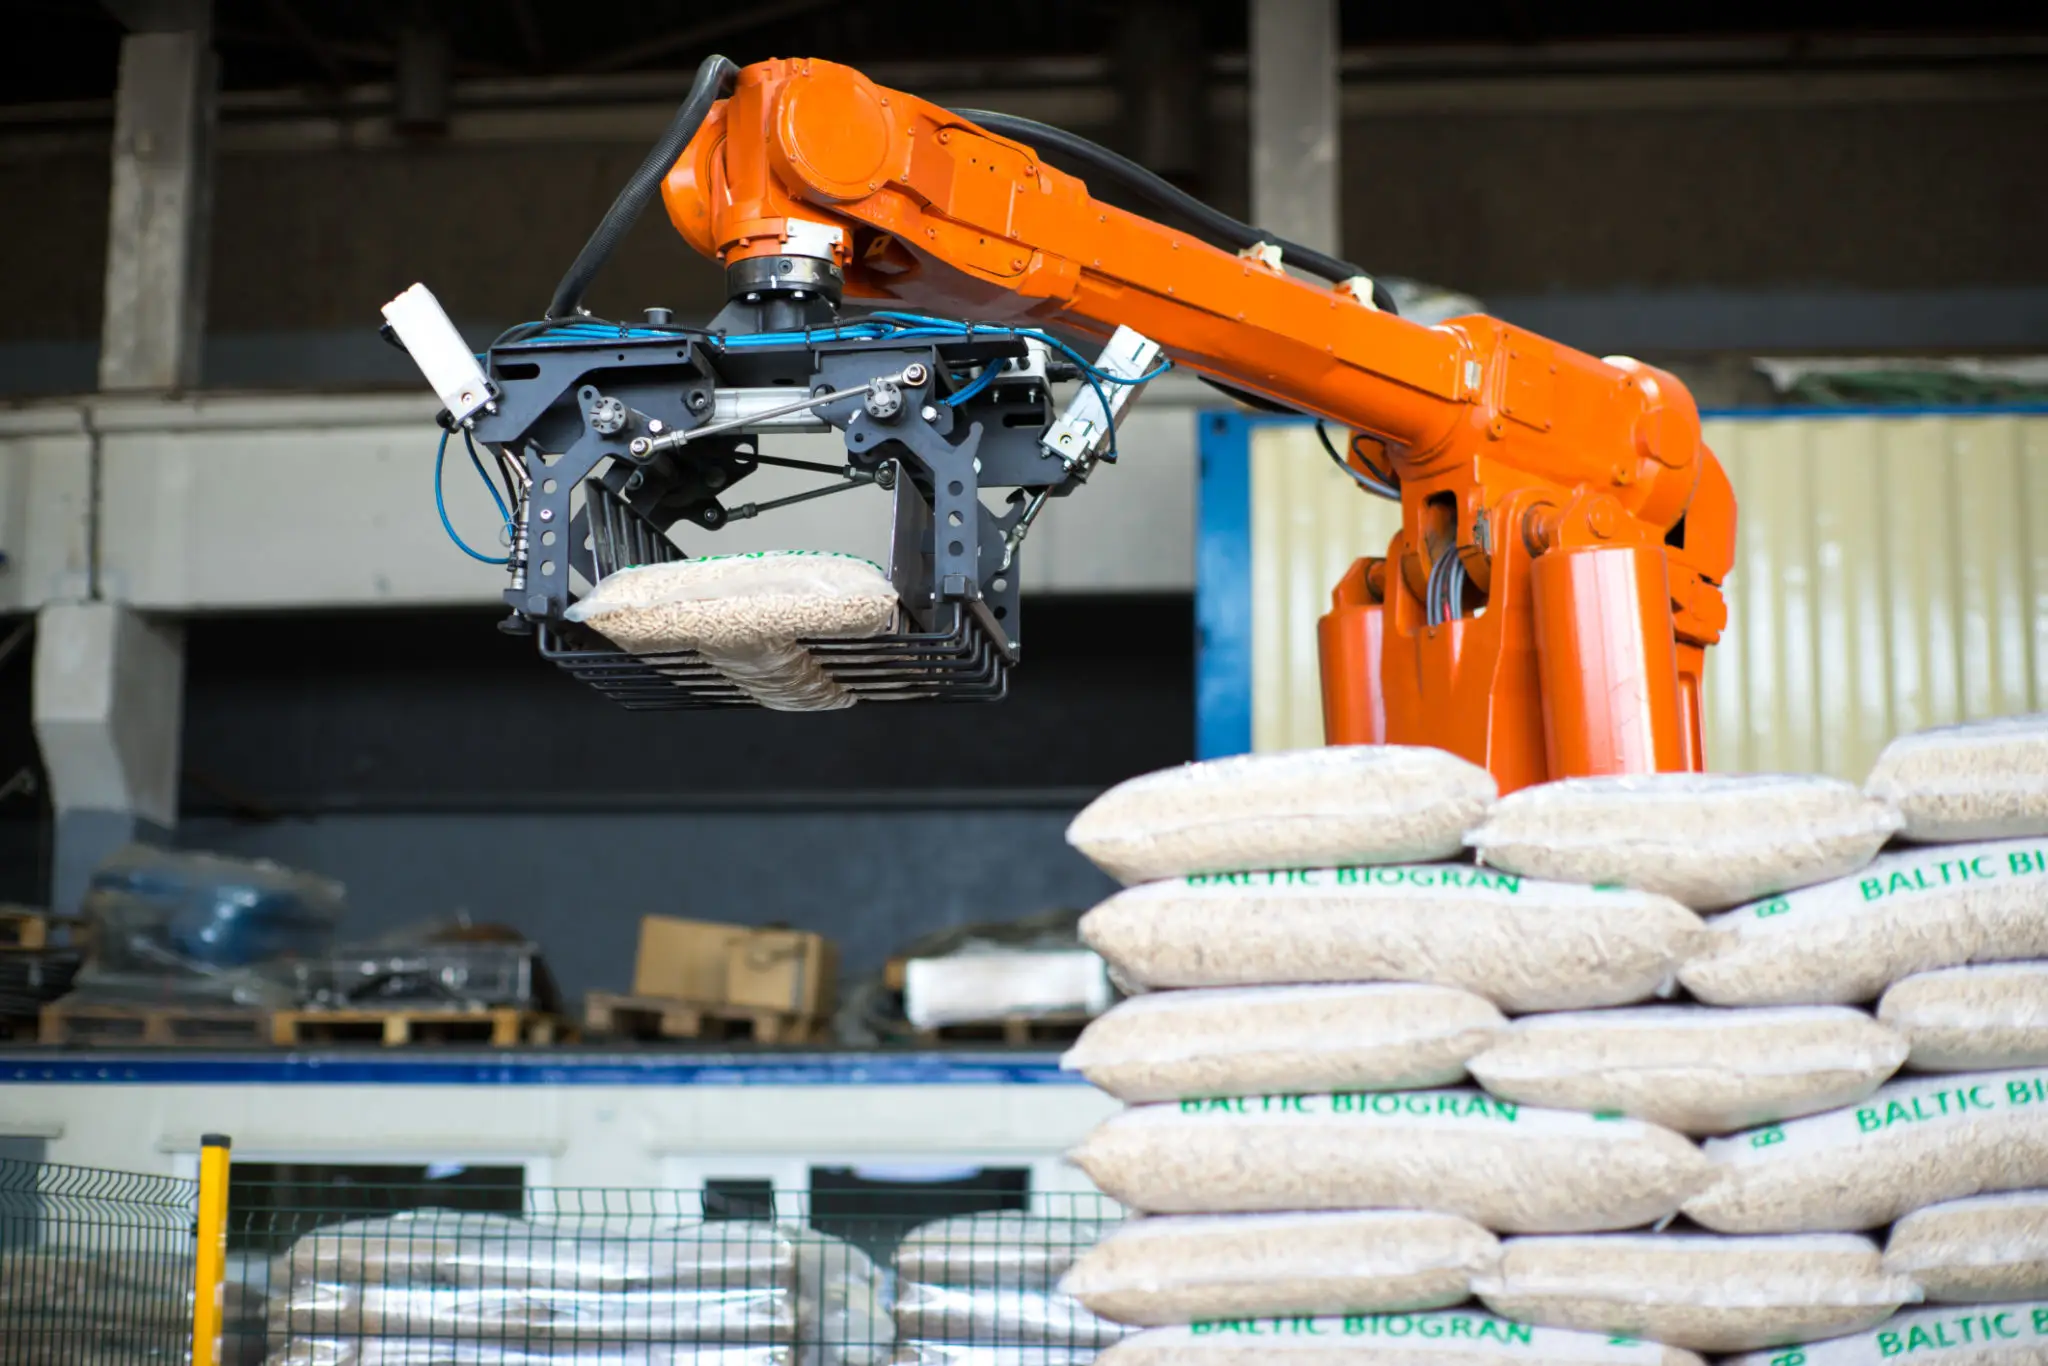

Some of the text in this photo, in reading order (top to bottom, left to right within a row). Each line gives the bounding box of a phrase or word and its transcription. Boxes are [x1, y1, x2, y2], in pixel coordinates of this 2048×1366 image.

[1336, 865, 1521, 894] BIOGRAN
[1859, 849, 2048, 902] BALTIC BI
[1331, 1091, 1519, 1123] BIOGRAN
[1854, 1078, 2048, 1134] BALTIC BI
[1342, 1313, 1533, 1344] BIOGRAN
[1875, 1312, 2021, 1358] BALTIC
